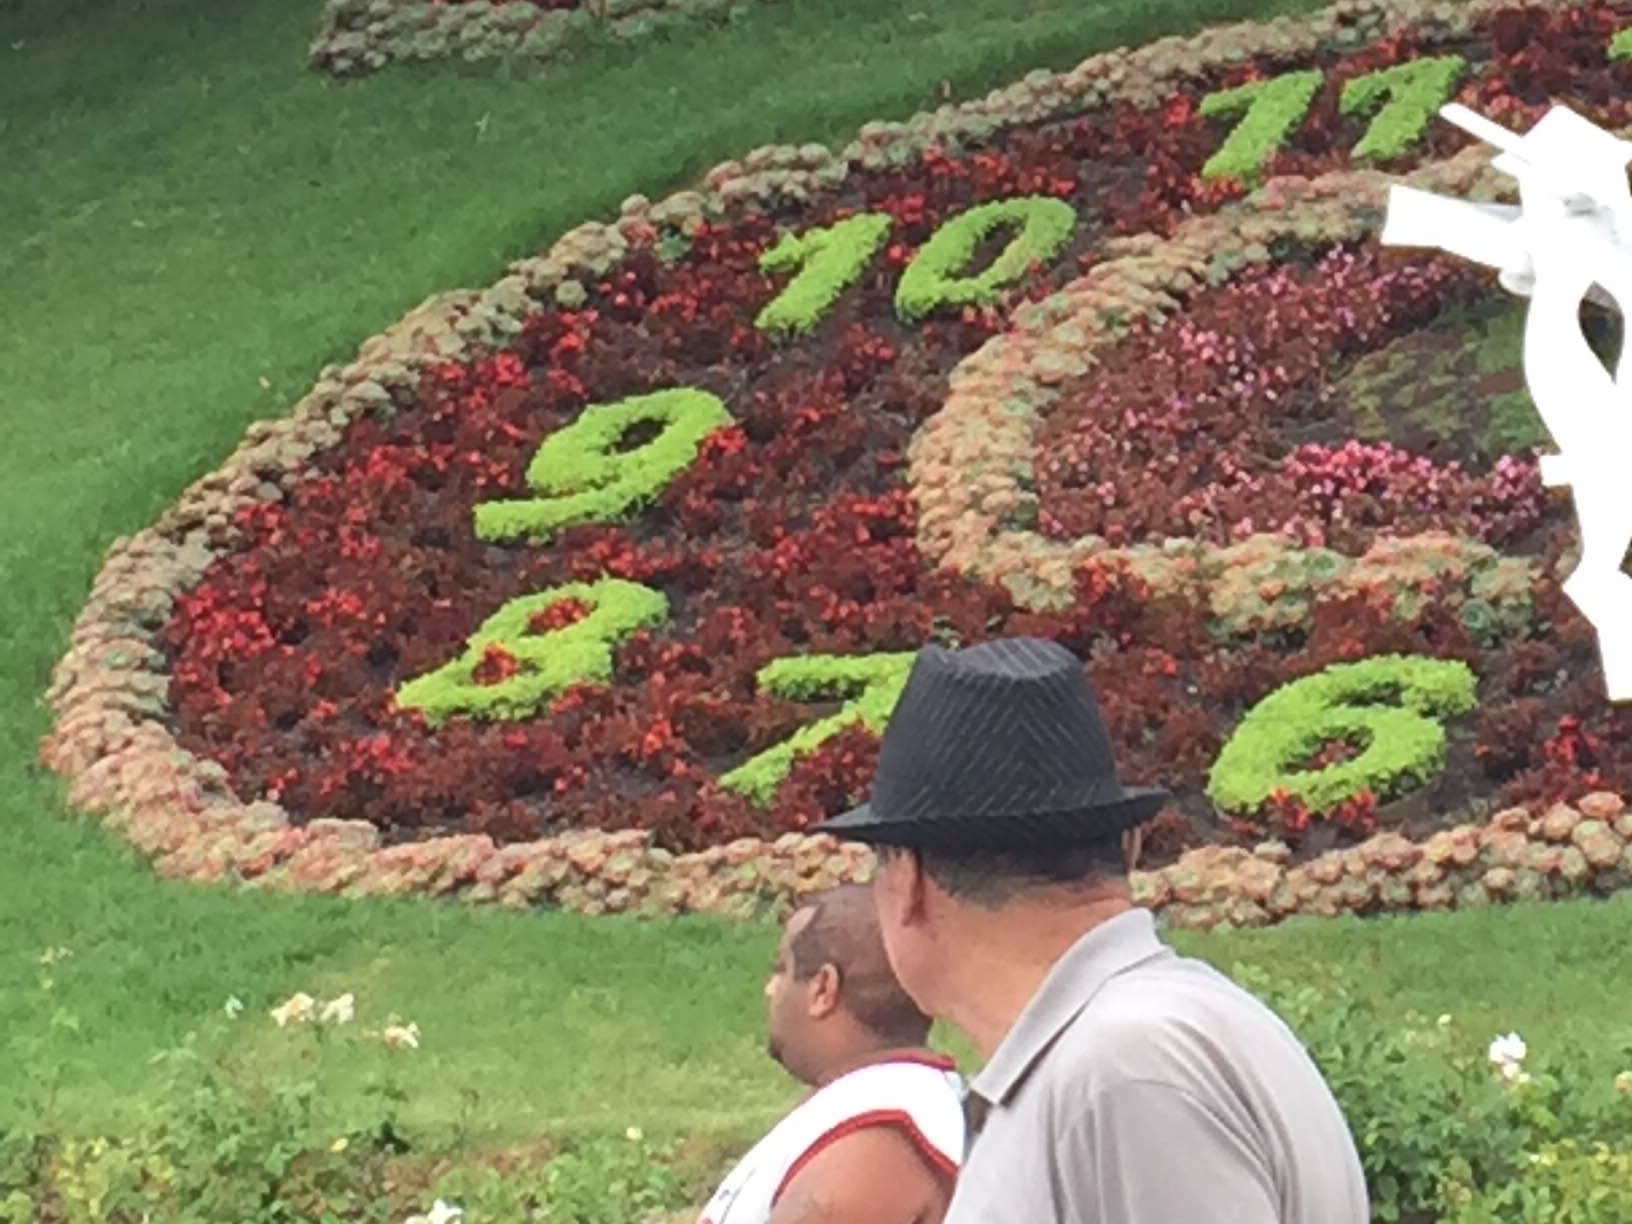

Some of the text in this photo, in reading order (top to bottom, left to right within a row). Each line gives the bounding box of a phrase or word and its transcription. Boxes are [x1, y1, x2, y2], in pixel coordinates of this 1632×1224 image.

[1201, 54, 1466, 179] 11
[755, 194, 1078, 332] 10
[474, 387, 735, 544] 9
[397, 576, 669, 726] 8
[720, 651, 918, 808] 7
[1207, 653, 1477, 811] 6
